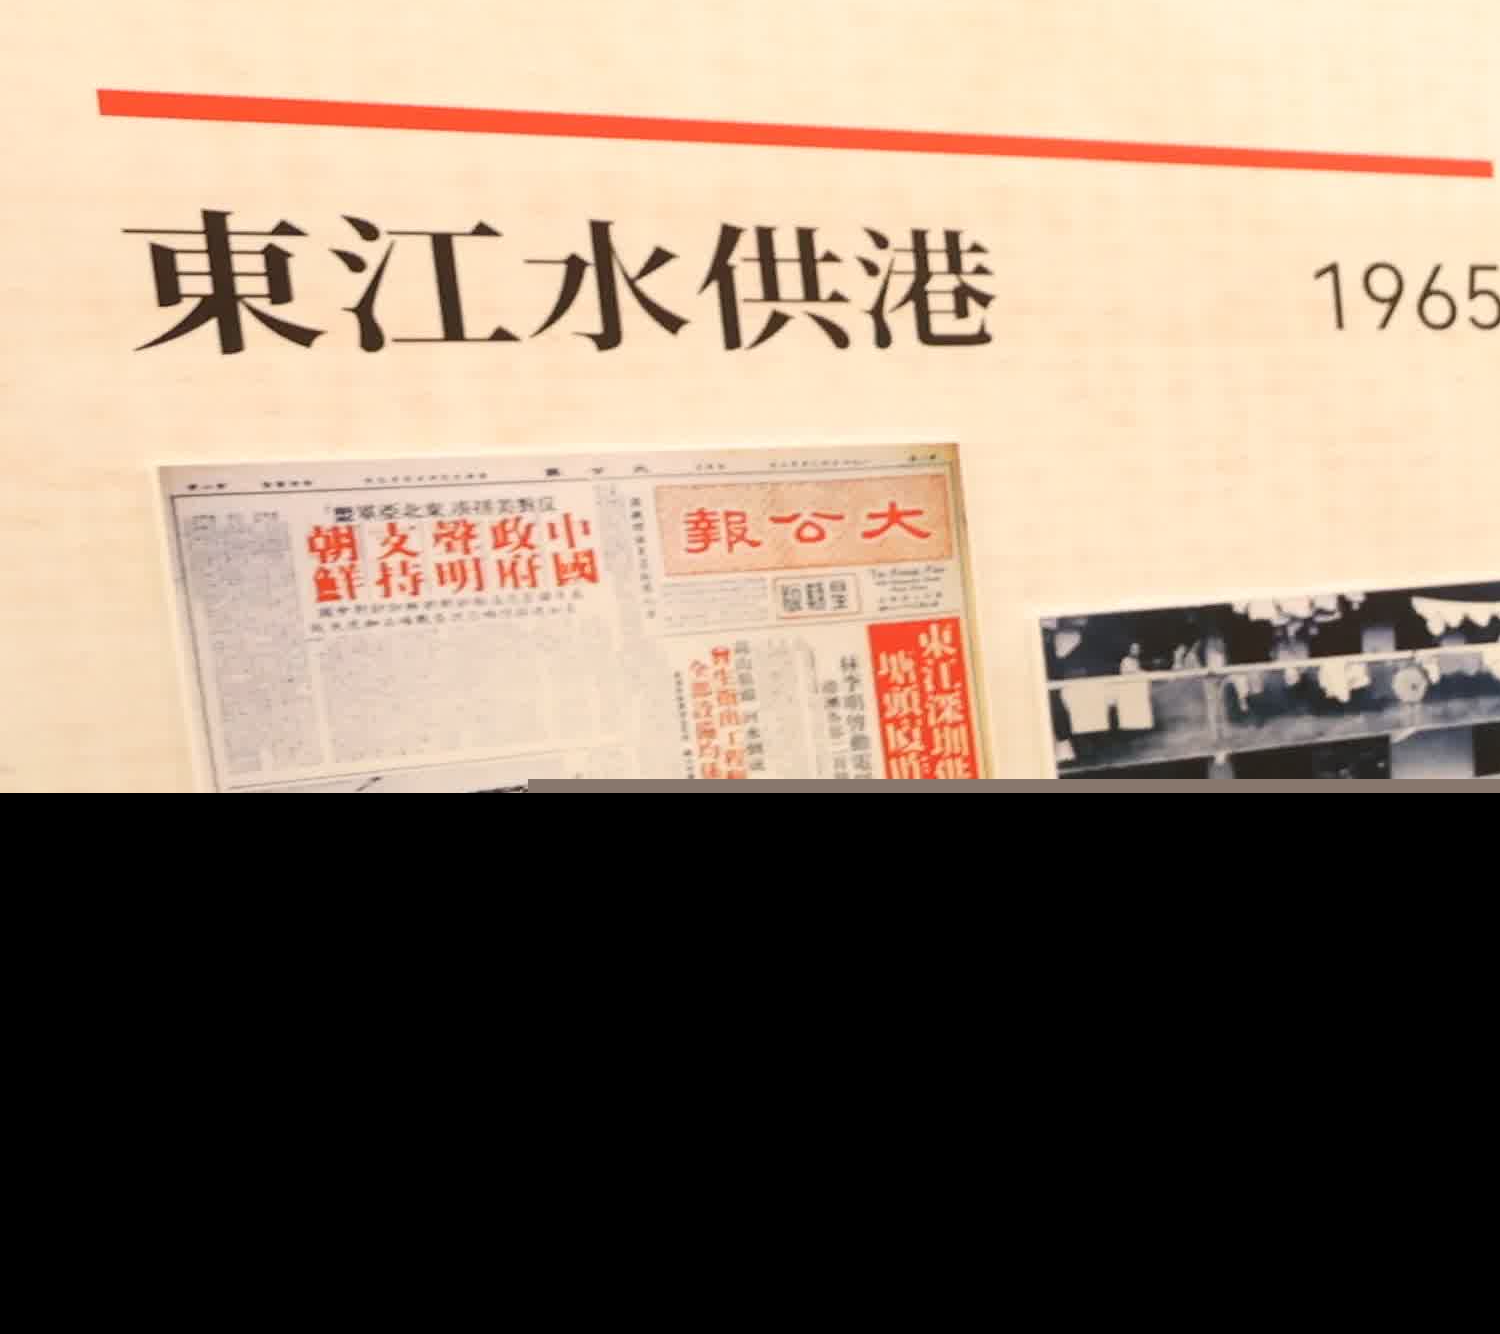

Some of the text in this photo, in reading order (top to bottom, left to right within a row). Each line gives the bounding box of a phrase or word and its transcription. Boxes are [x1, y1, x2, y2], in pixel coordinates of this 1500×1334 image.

[120, 207, 996, 357] 東江水供港
